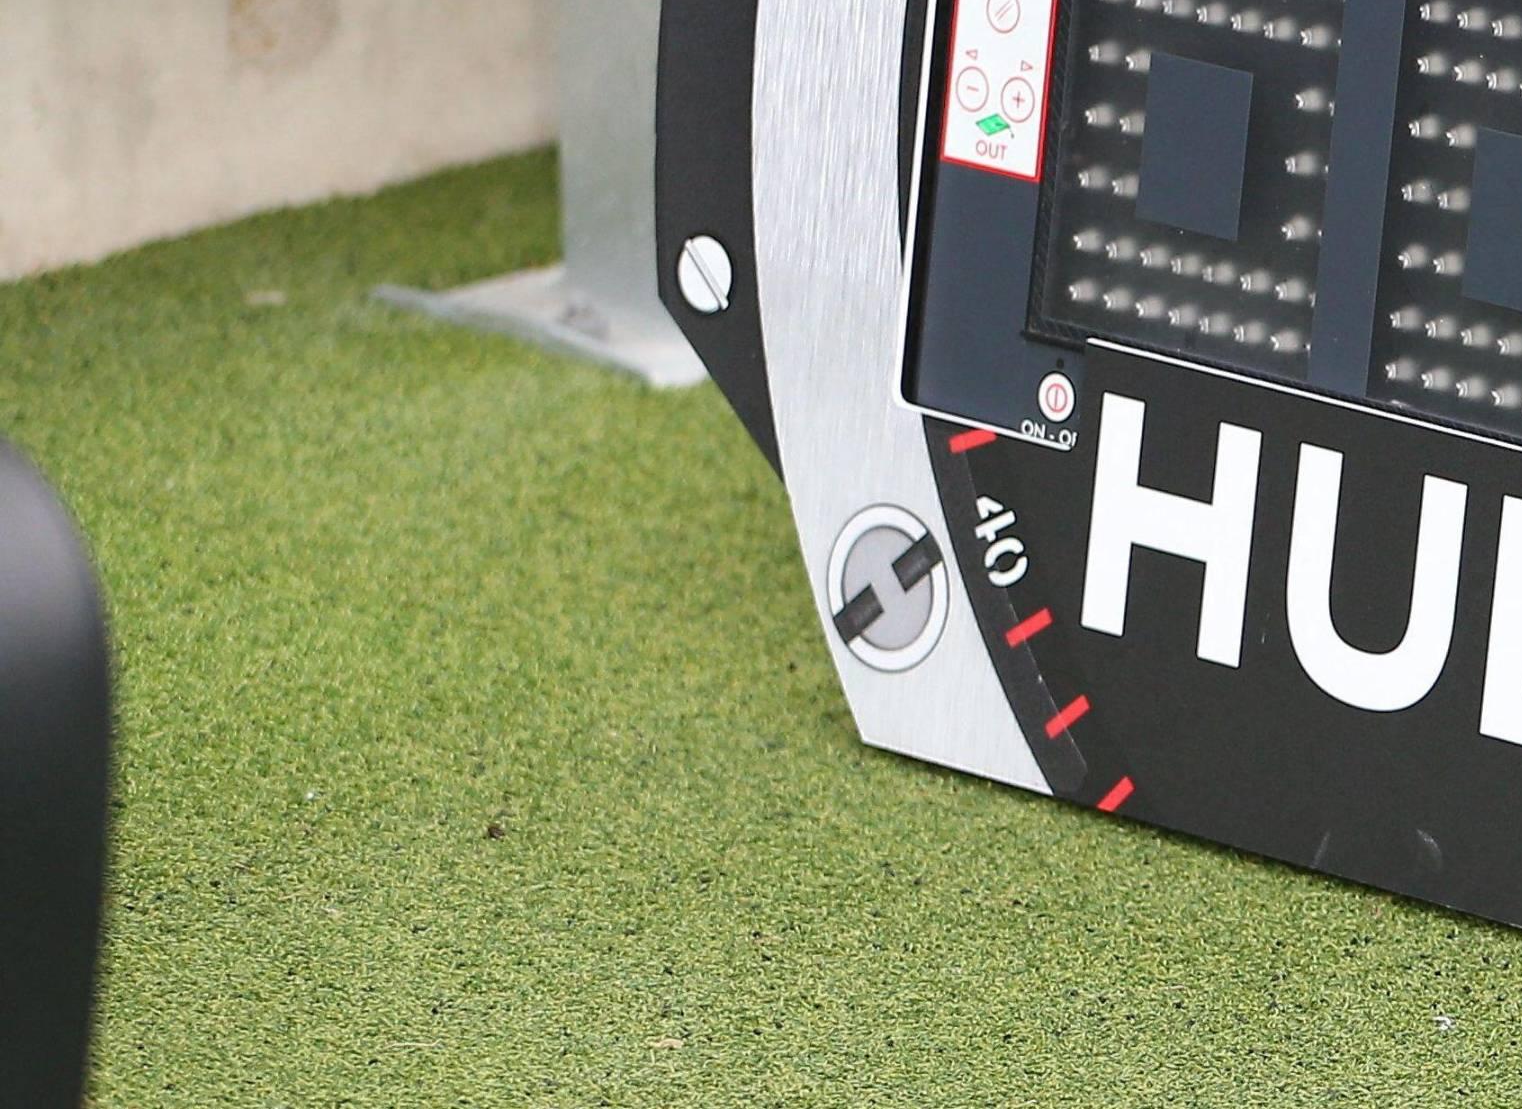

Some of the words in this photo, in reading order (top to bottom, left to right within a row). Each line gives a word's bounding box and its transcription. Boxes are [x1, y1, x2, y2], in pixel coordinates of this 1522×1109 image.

[976, 139, 1008, 161] OUT
[1021, 419, 1046, 441] ON
[975, 495, 1029, 587] 40
